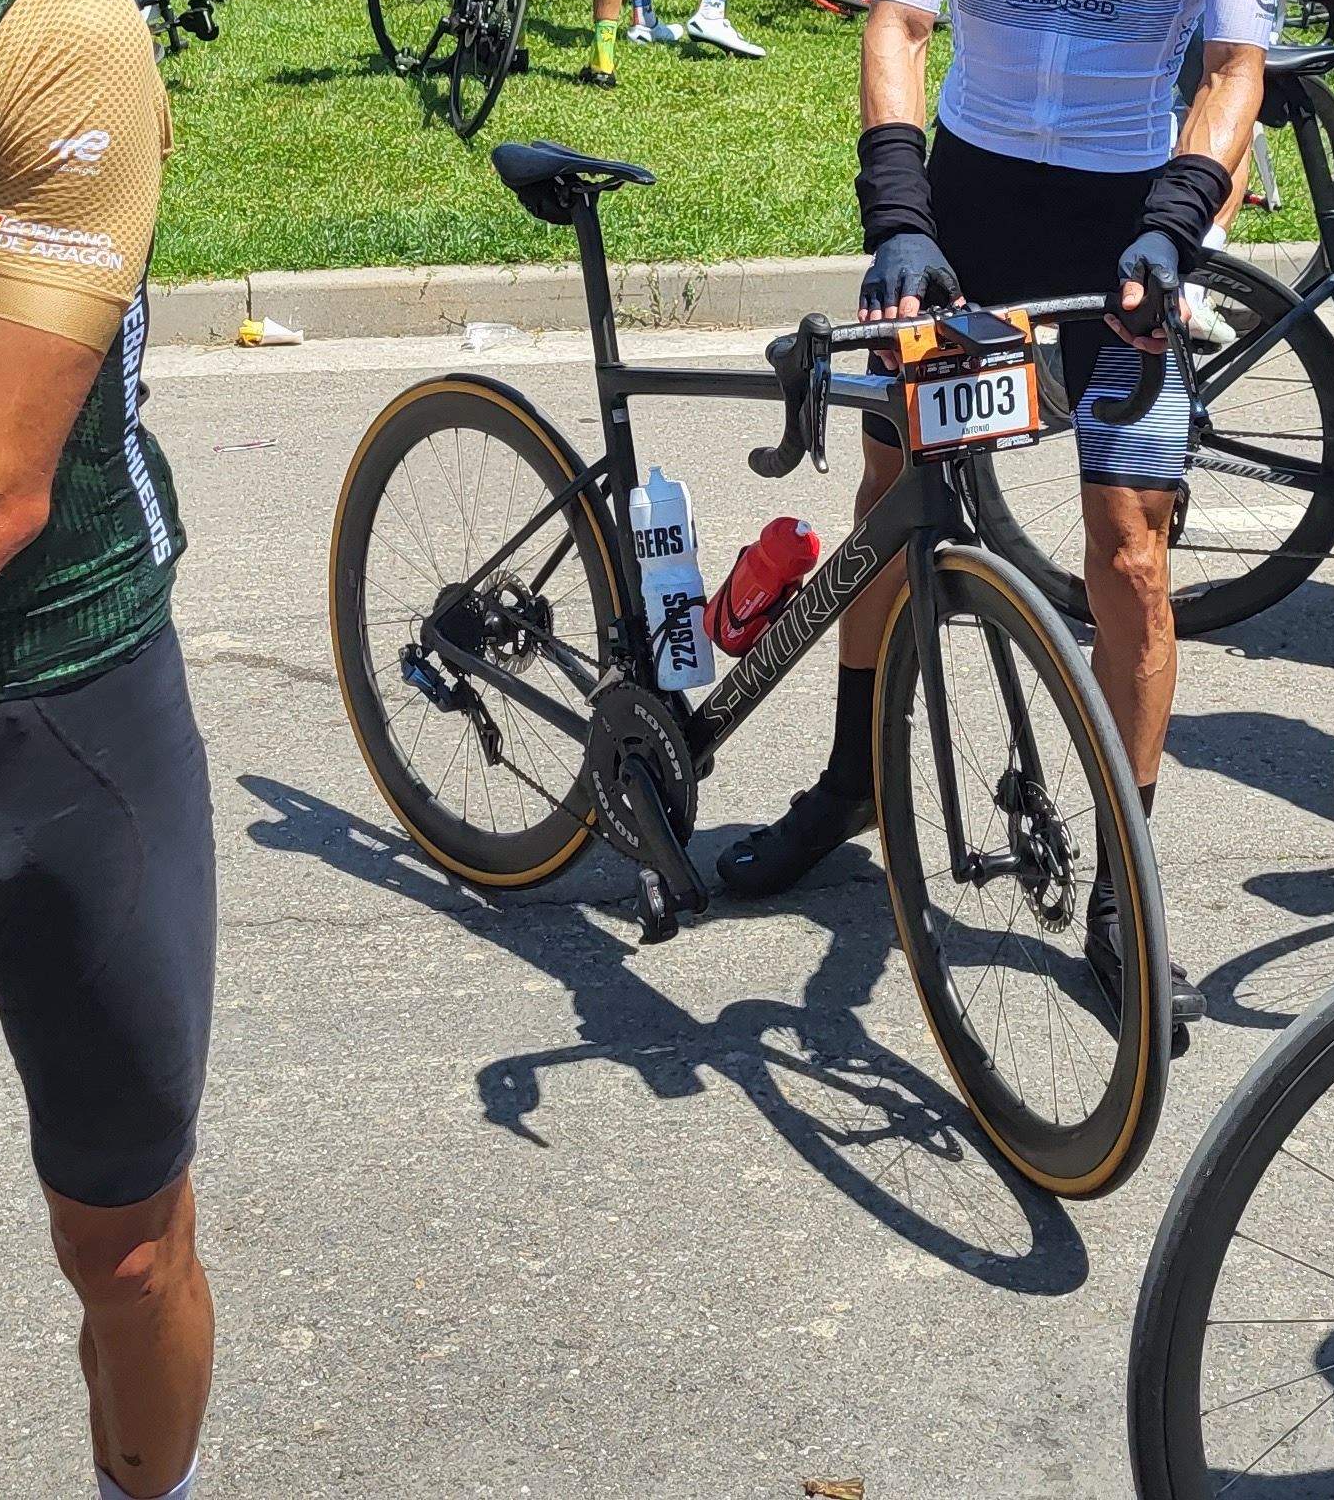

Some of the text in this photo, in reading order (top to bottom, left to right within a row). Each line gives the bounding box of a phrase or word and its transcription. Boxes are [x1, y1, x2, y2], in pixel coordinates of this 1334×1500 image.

[2, 217, 112, 250] GOBIERNO
[932, 375, 1016, 427] 1003
[961, 423, 990, 435] ANTONIO
[702, 520, 878, 740] S-WORKS
[634, 703, 683, 781] ROTOR
[592, 770, 639, 848] ROTOR
